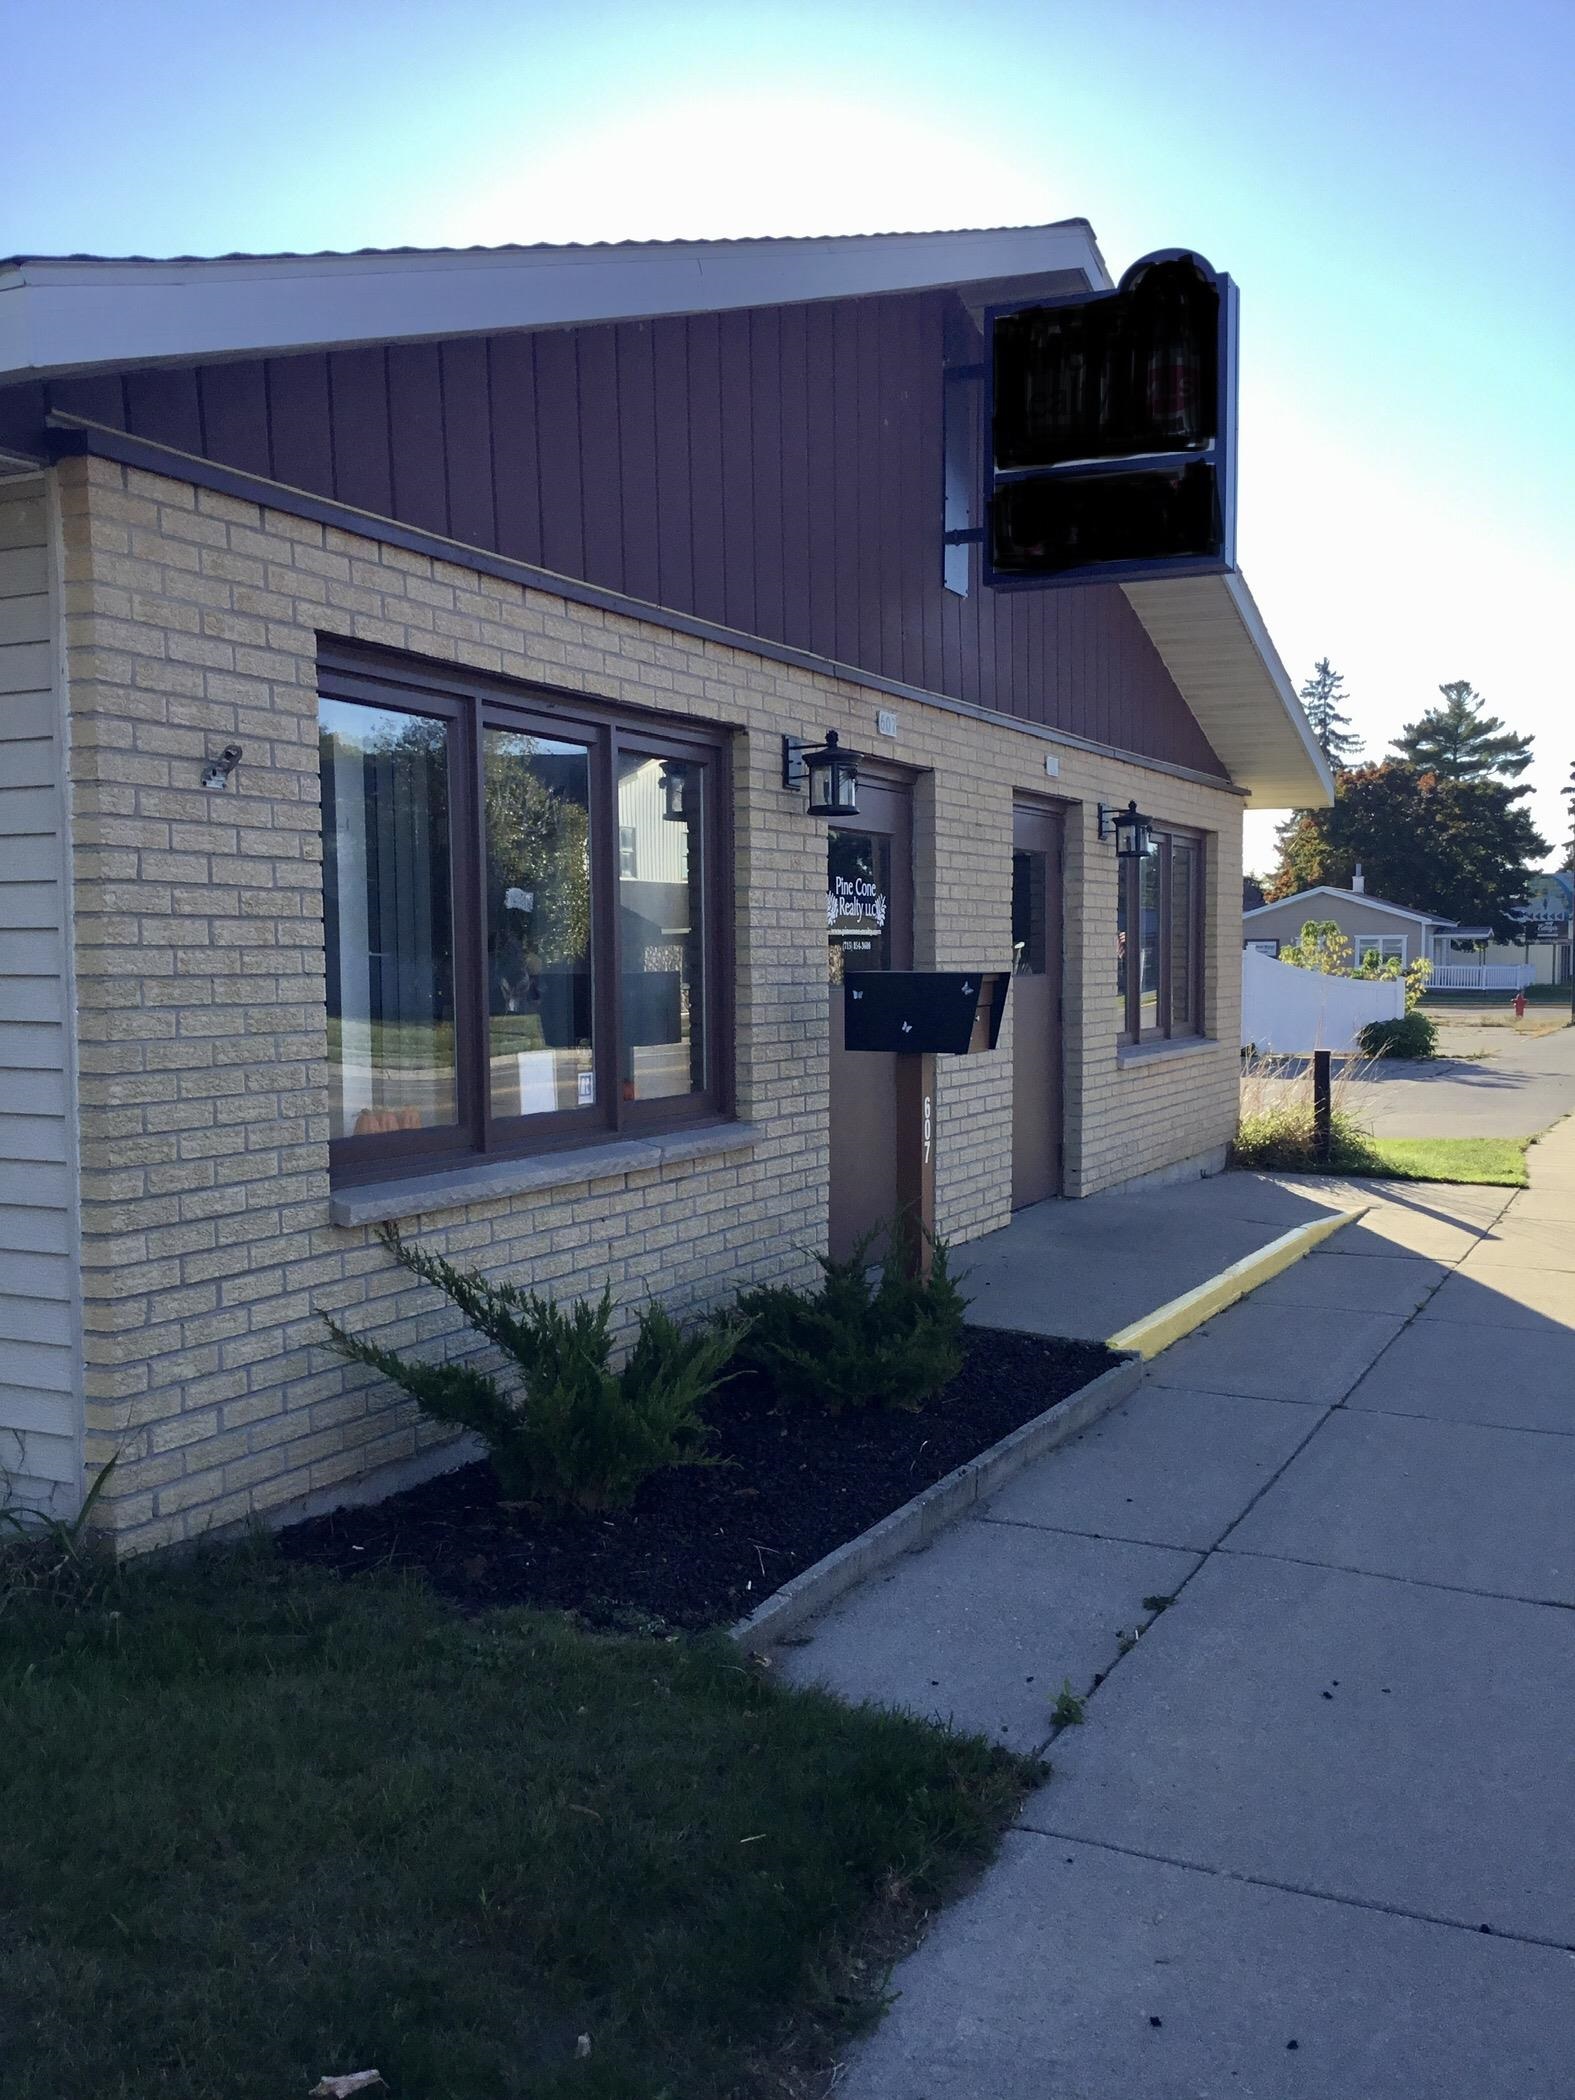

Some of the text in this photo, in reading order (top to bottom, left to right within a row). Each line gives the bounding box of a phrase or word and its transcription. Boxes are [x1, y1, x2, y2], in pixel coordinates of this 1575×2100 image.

[835, 876, 877, 897] Pine Cone
[839, 896, 864, 923] Realty
